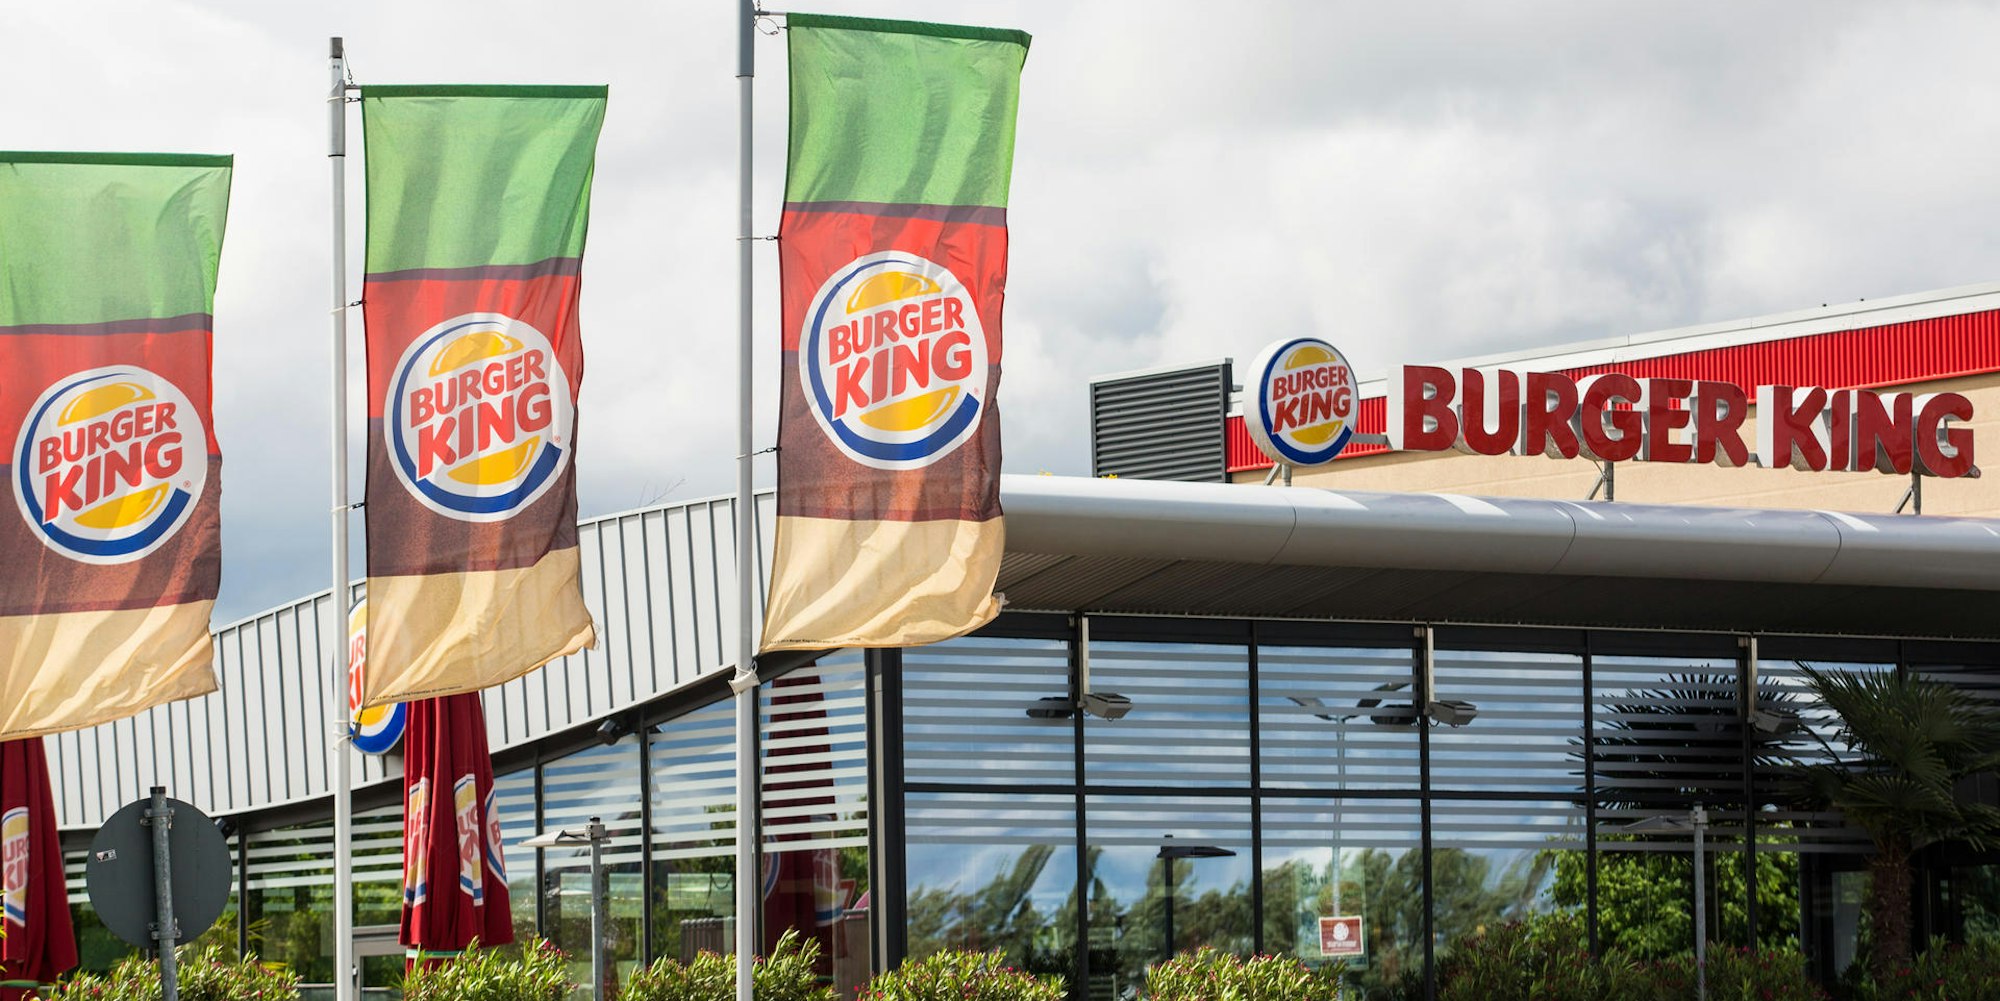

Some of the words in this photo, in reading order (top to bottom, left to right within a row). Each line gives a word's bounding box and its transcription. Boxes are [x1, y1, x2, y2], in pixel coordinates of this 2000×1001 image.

[828, 297, 965, 366] BURGER
[410, 349, 545, 428] BURGER
[834, 331, 972, 418] KING
[1273, 366, 1348, 401] BURGER
[1273, 387, 1351, 433] KING
[39, 402, 176, 475] BURGER
[419, 382, 552, 478] KING
[1402, 365, 1749, 468] BURGER
[1772, 385, 1976, 478] KING
[45, 432, 182, 522] KING
